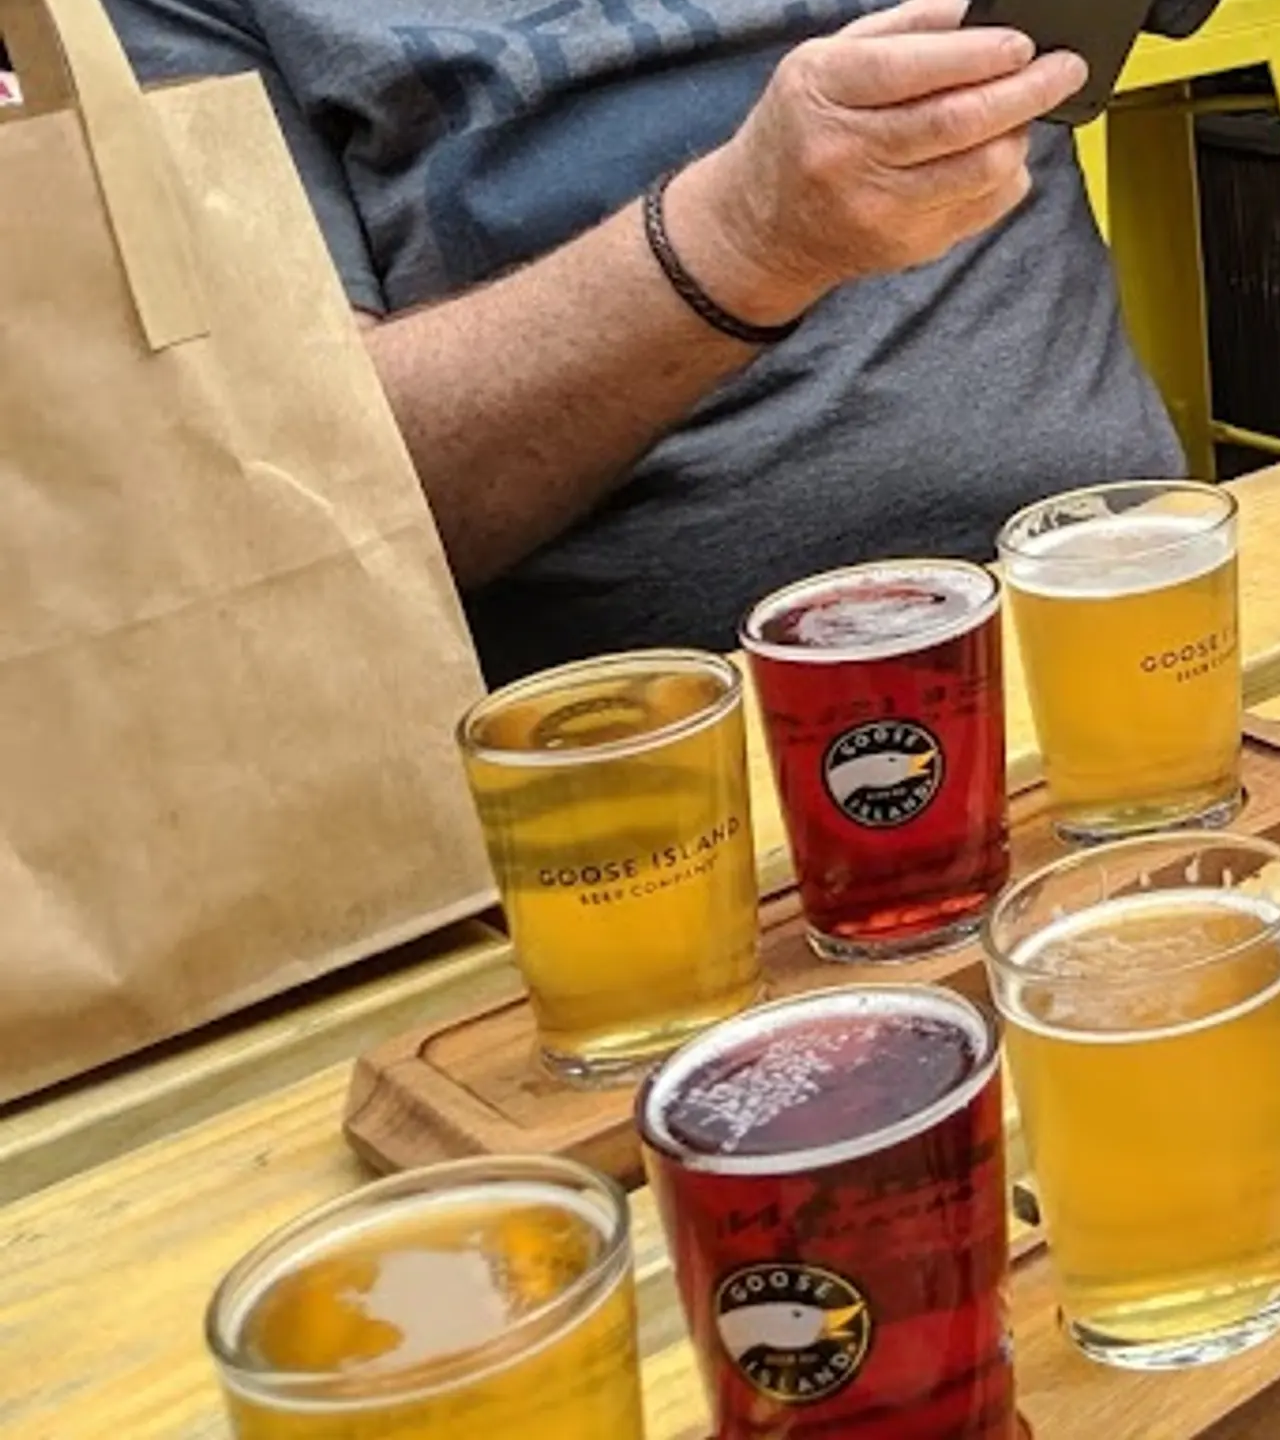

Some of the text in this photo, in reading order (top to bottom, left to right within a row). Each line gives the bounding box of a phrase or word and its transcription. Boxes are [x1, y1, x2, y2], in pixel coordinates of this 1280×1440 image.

[1139, 633, 1218, 674] GOOSE
[840, 728, 920, 756] GOOSE
[849, 782, 929, 821] ISLAND
[538, 816, 741, 888] GOOSE ISLAND
[629, 851, 720, 898] COMPANY
[729, 1270, 835, 1303] GOOSE
[745, 1351, 852, 1393] ISLAND
